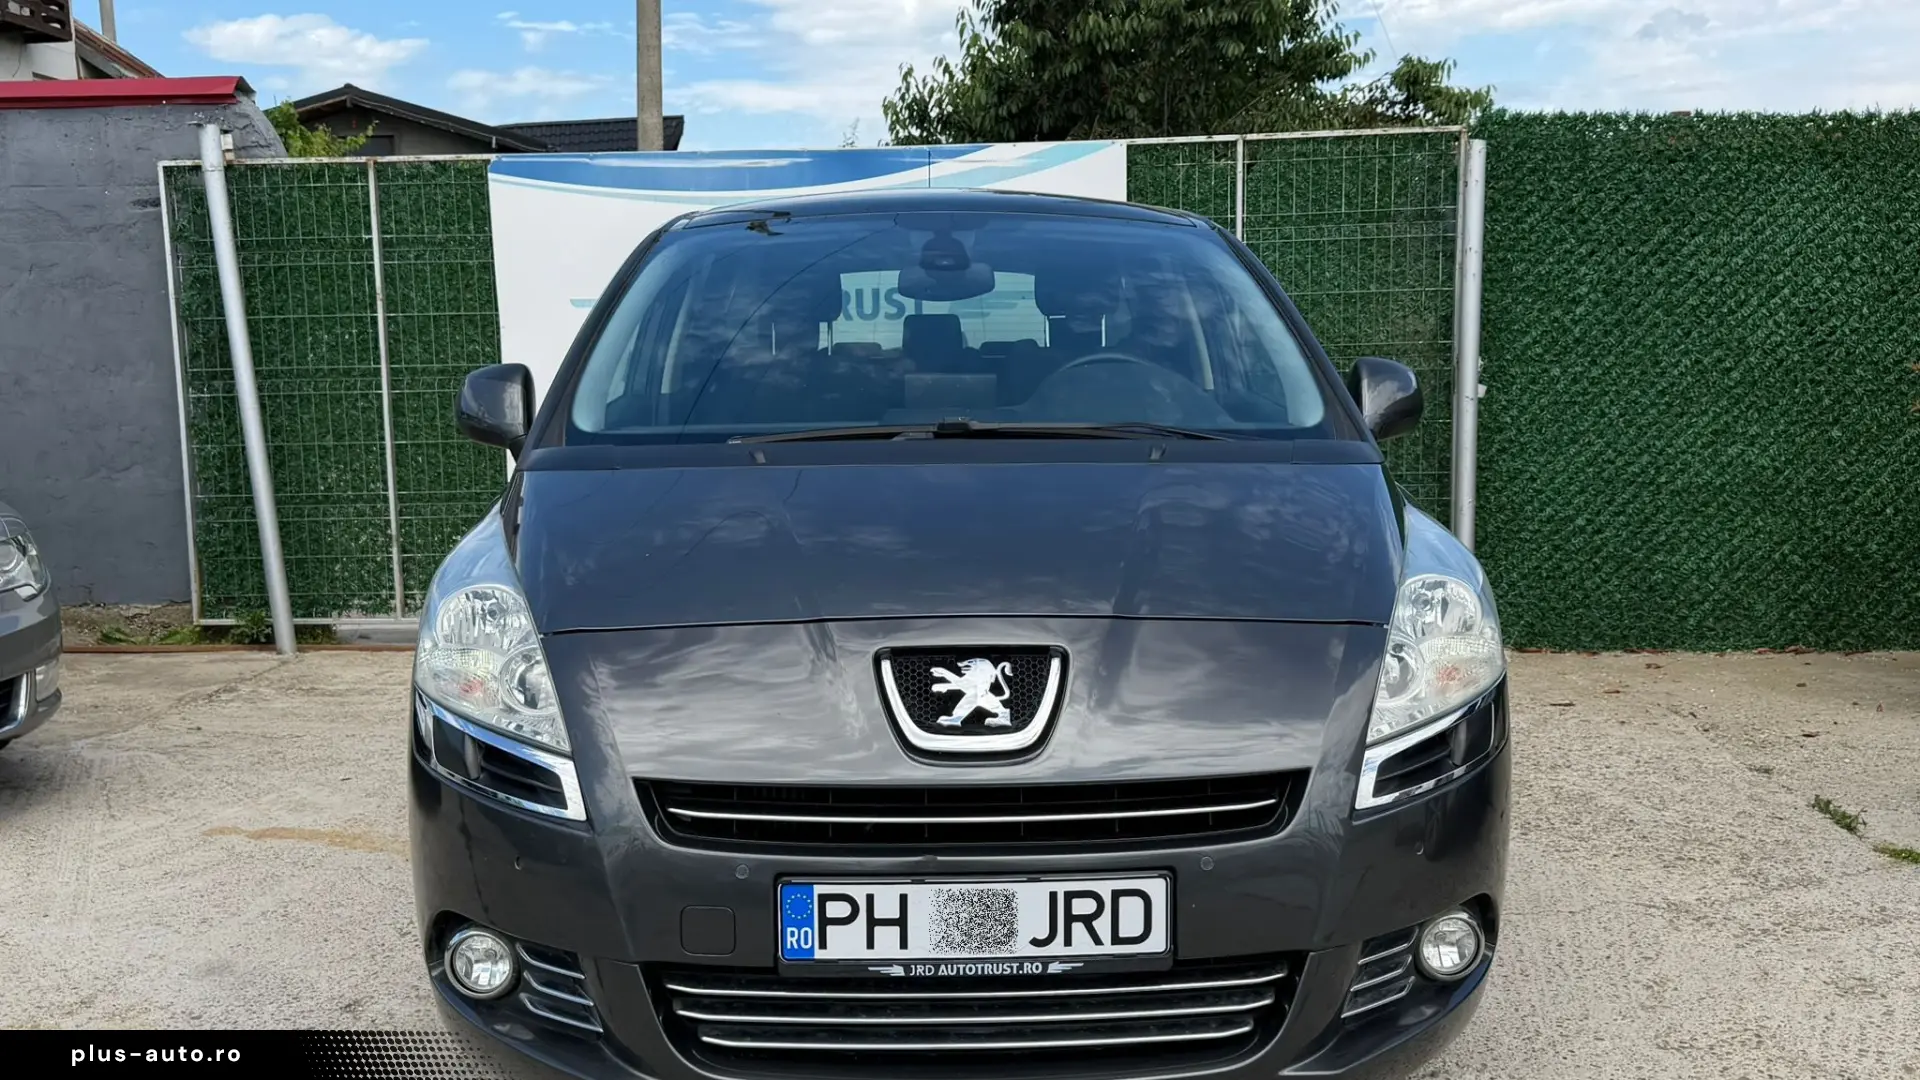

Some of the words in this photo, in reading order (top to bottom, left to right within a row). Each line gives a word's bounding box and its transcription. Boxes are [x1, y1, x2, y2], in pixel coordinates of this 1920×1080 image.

[817, 893, 908, 950] PH
[1028, 888, 1153, 948] JRD
[786, 926, 812, 950] RO
[909, 964, 935, 976] JRD
[937, 962, 1043, 976] AUTOTRUST.RO
